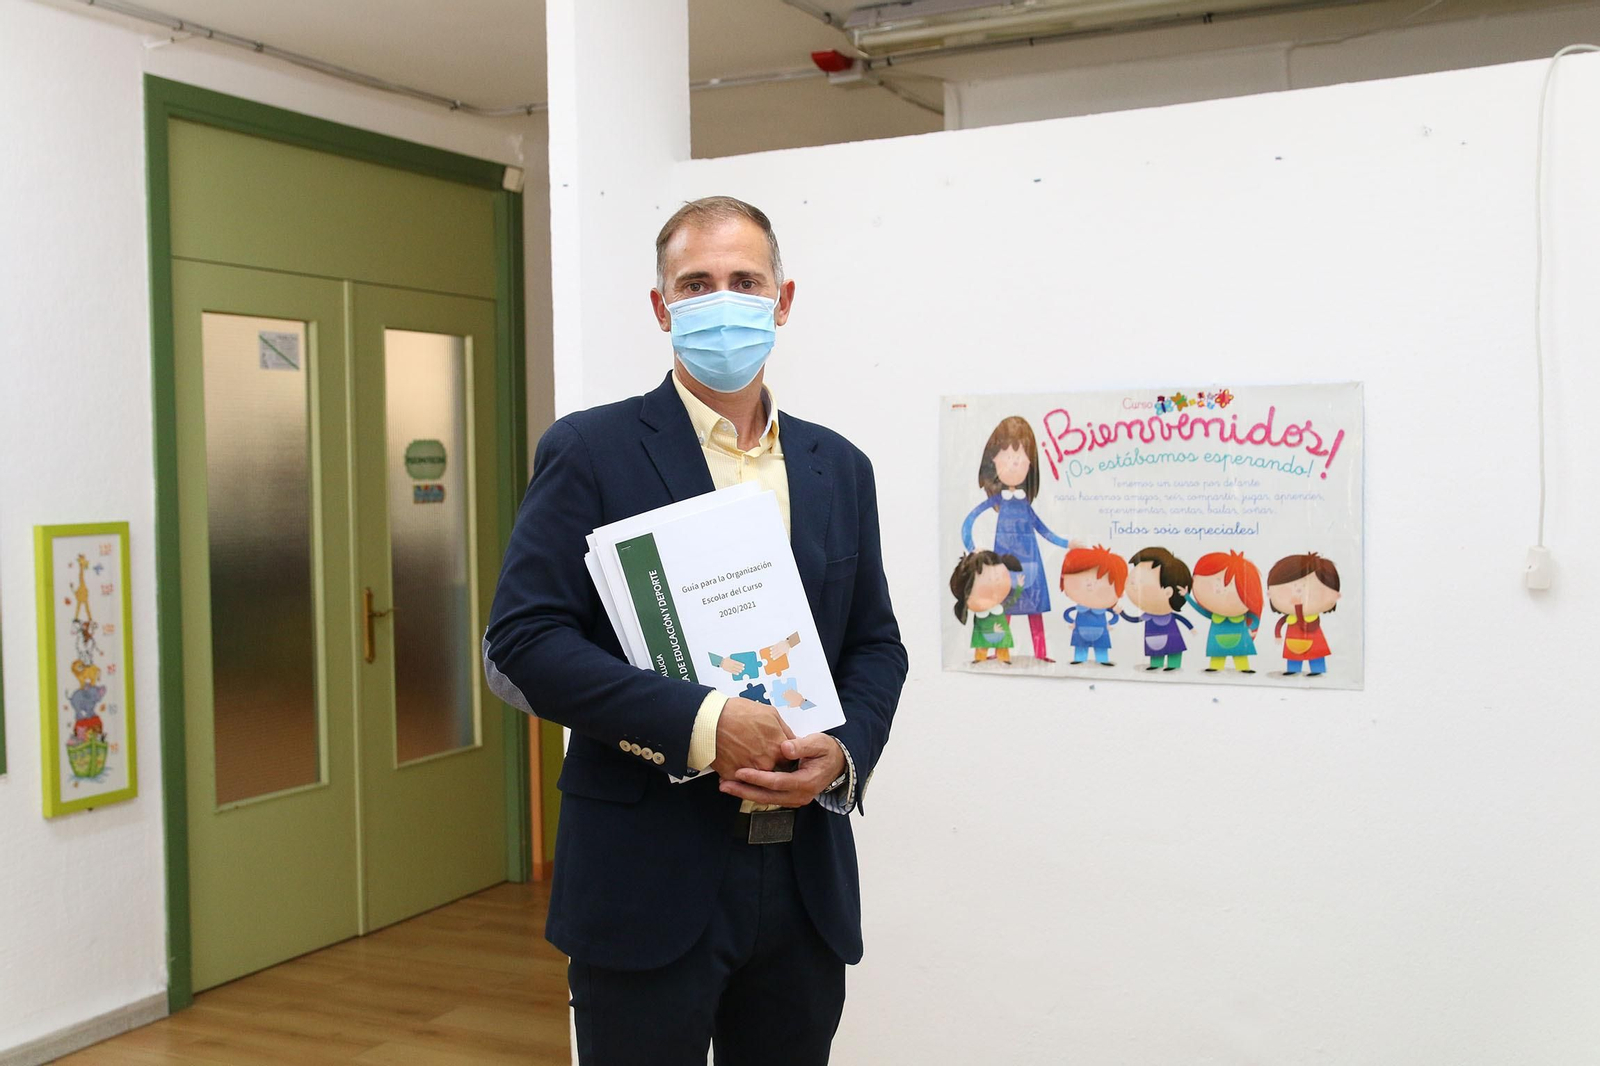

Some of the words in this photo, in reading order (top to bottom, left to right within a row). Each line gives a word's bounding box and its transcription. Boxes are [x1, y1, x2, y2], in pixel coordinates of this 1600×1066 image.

[1122, 397, 1153, 409] Curso
[1042, 406, 1345, 480] ¡Bienvenidos!
[1098, 447, 1199, 471] estábamos
[1204, 452, 1315, 478] esperando!
[1203, 480, 1221, 491] por
[1109, 520, 1149, 539] ¡Todos
[1153, 523, 1181, 535] sois
[1184, 521, 1259, 540] especiales!
[648, 569, 667, 608] DEPORTE
[681, 582, 700, 594] Guía
[700, 577, 718, 590] para
[718, 575, 726, 583] la
[726, 560, 773, 580] Organización
[701, 592, 729, 606] Escolar
[730, 588, 742, 598] del
[742, 582, 763, 594] Curso
[718, 600, 757, 618] 2020/2021
[662, 613, 683, 662] EDUCACIÓN
[677, 662, 688, 674] DE
